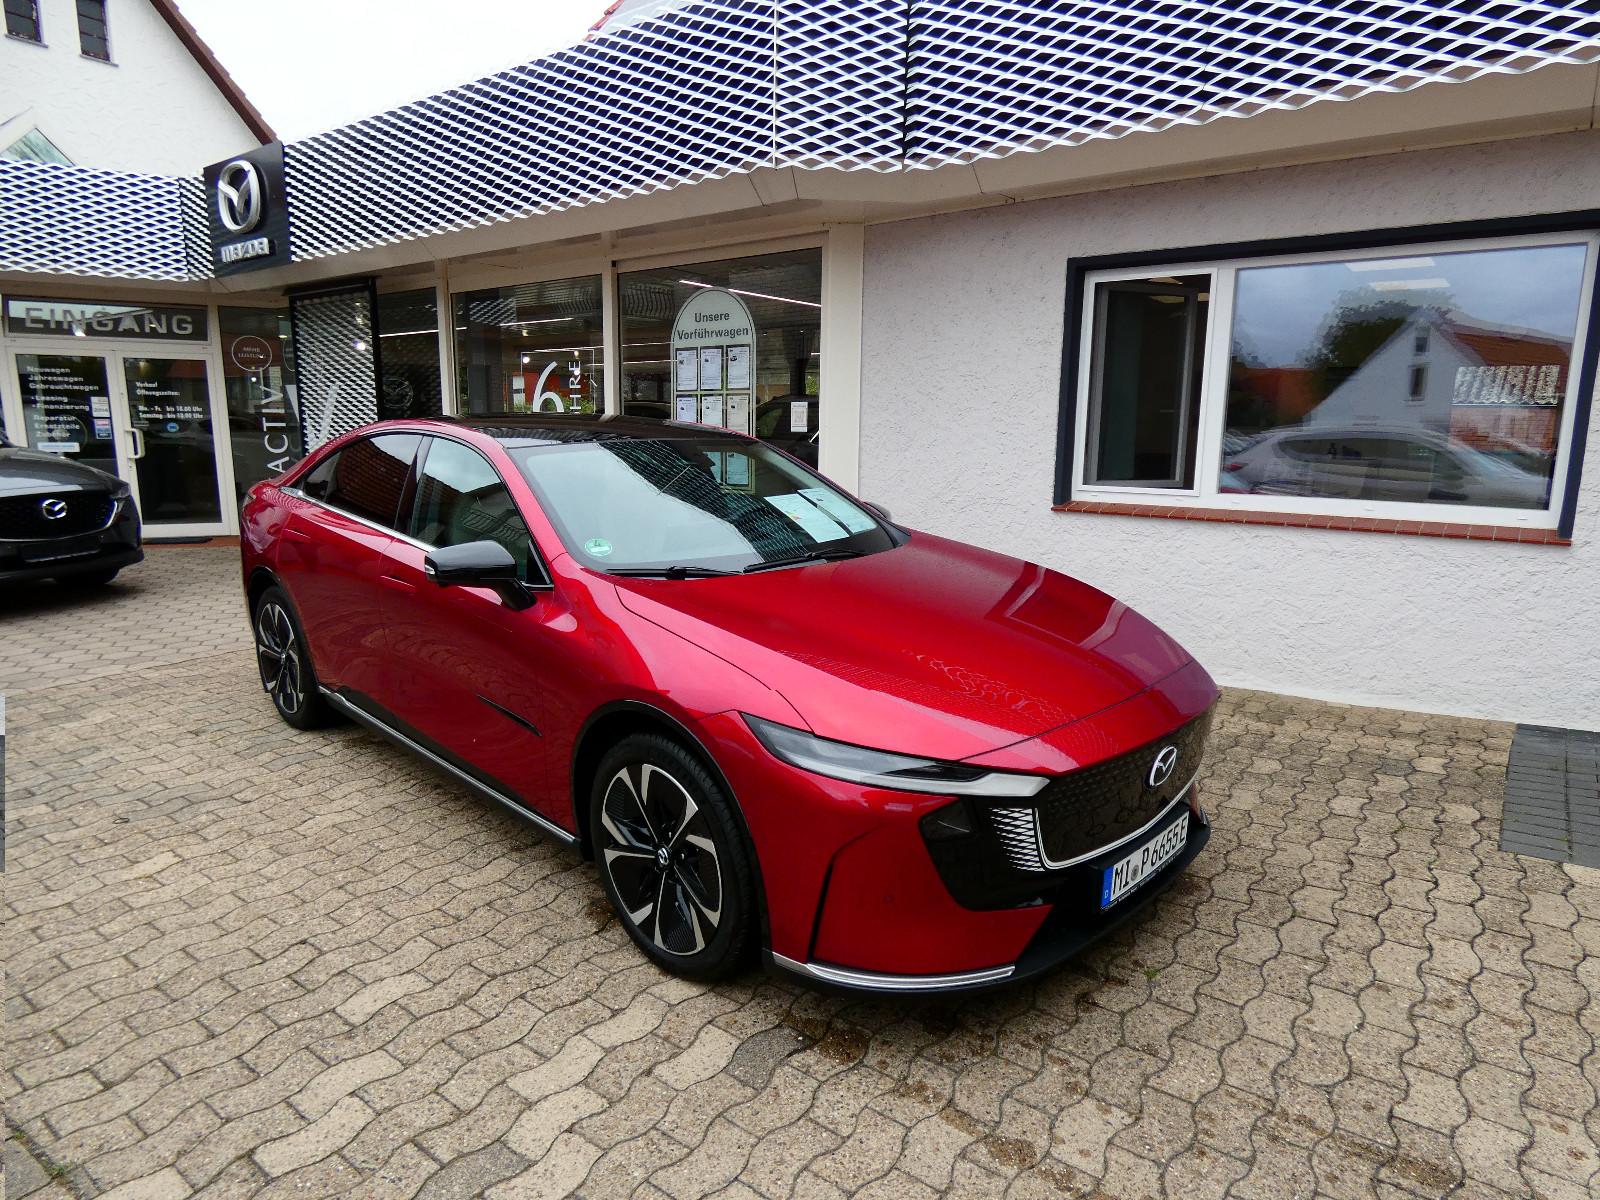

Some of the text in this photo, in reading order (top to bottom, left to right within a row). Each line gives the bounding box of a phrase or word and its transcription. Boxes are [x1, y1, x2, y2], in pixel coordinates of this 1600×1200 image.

[25, 307, 193, 335] EINGANG
[694, 312, 730, 323] Unsere
[677, 326, 749, 340] Vorführwagen
[28, 374, 84, 384] Jahreswagen
[29, 382, 99, 392] Gebrauchtwagen
[569, 361, 582, 414] HRE
[259, 385, 289, 477] ACTIV
[1113, 860, 1131, 895] MI
